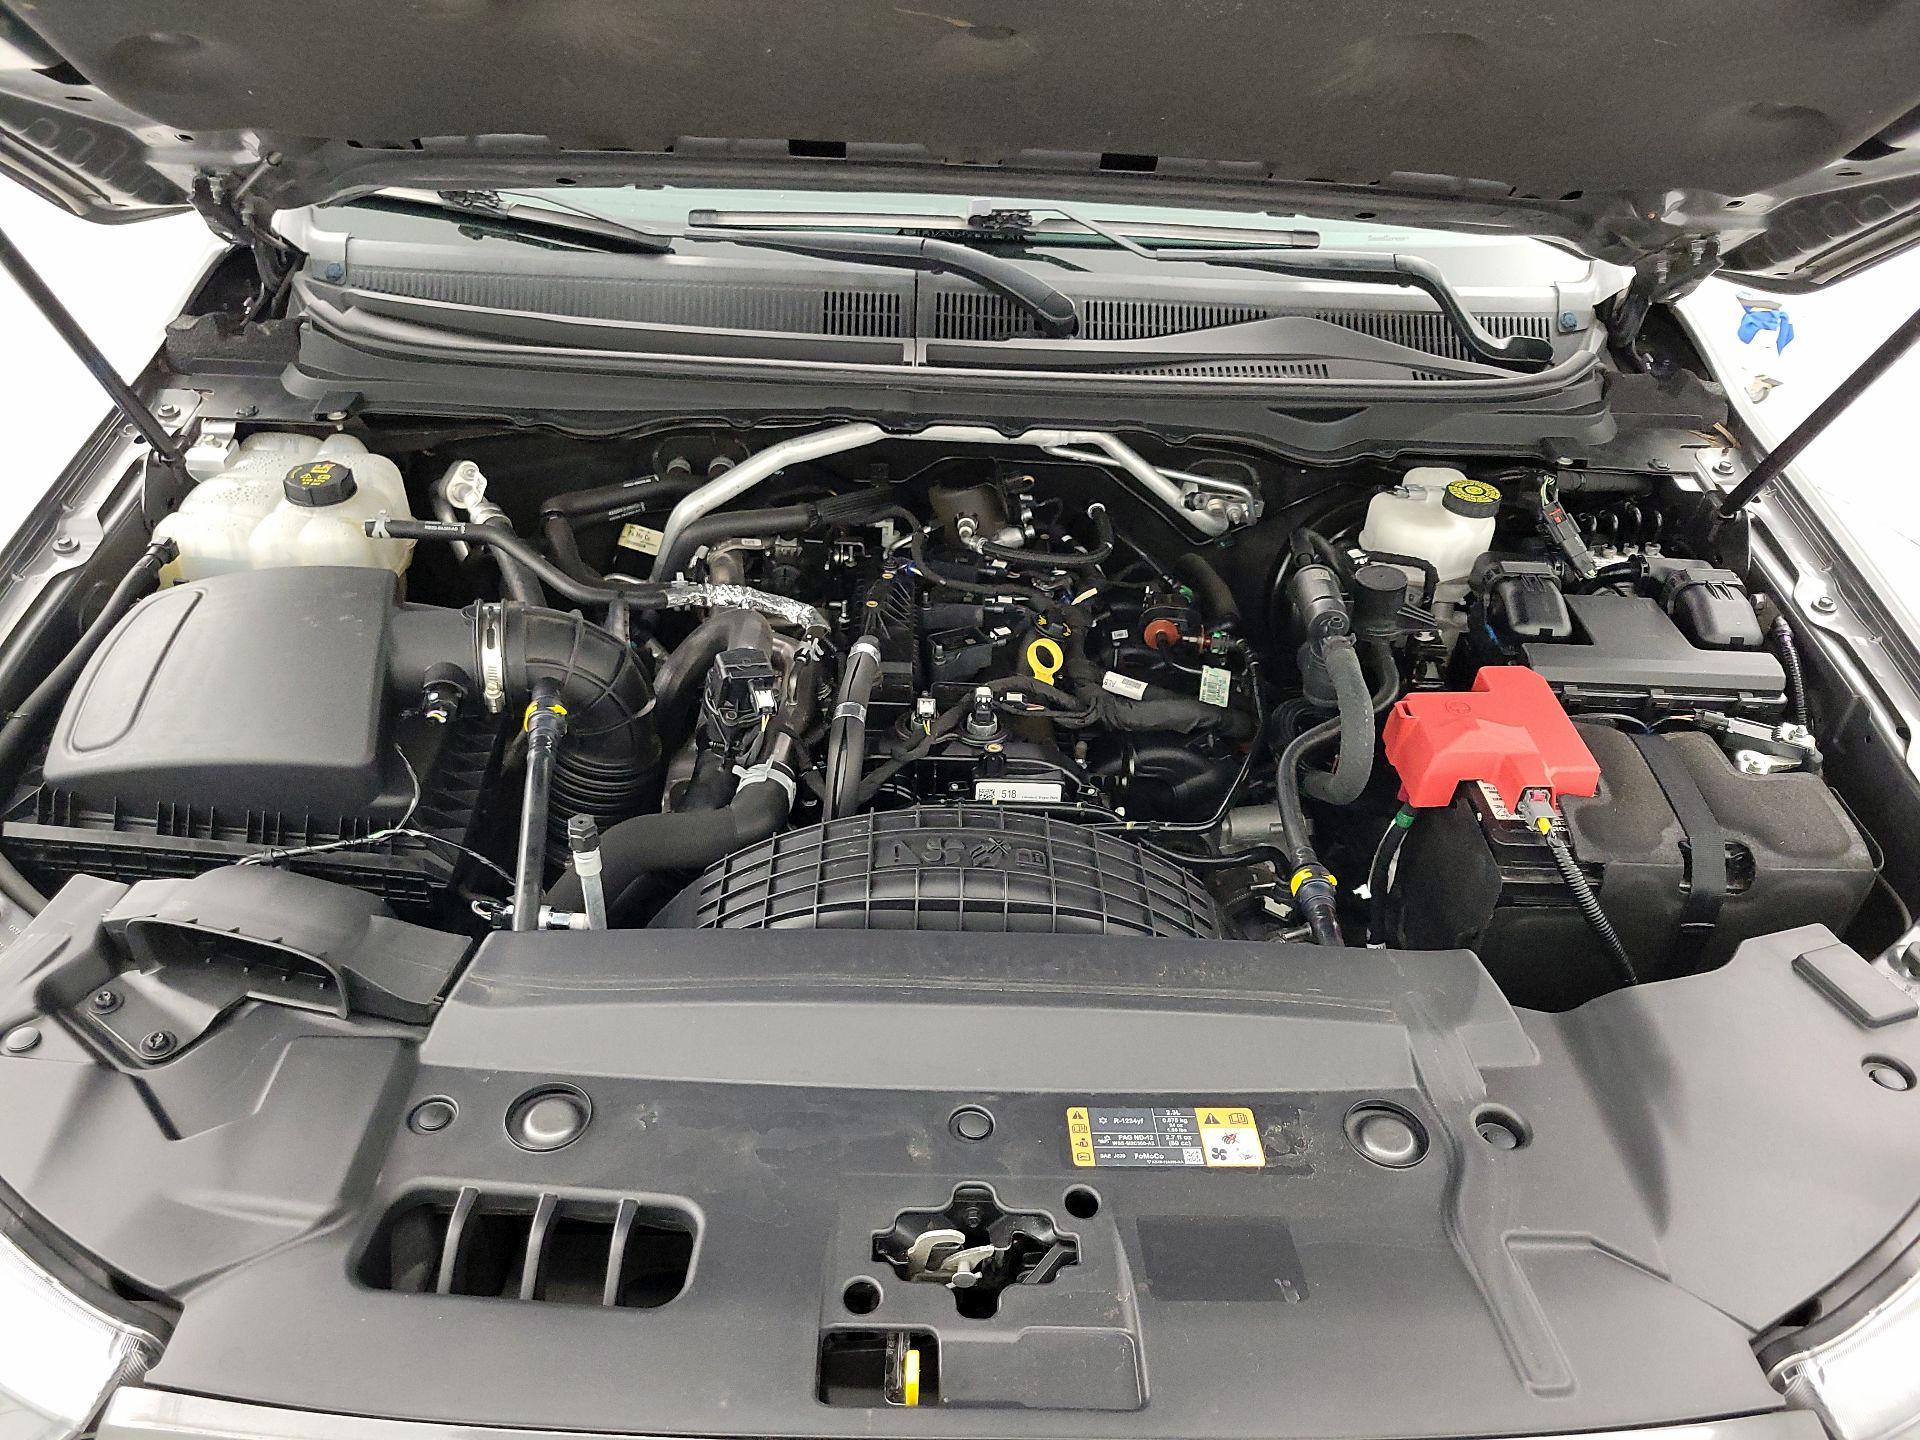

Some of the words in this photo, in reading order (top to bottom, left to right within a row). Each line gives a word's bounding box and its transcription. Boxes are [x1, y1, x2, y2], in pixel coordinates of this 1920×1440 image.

[1001, 789, 1017, 799] 518
[1113, 1117, 1144, 1125] R-1234yf
[1134, 1152, 1165, 1160] FoMoCo
